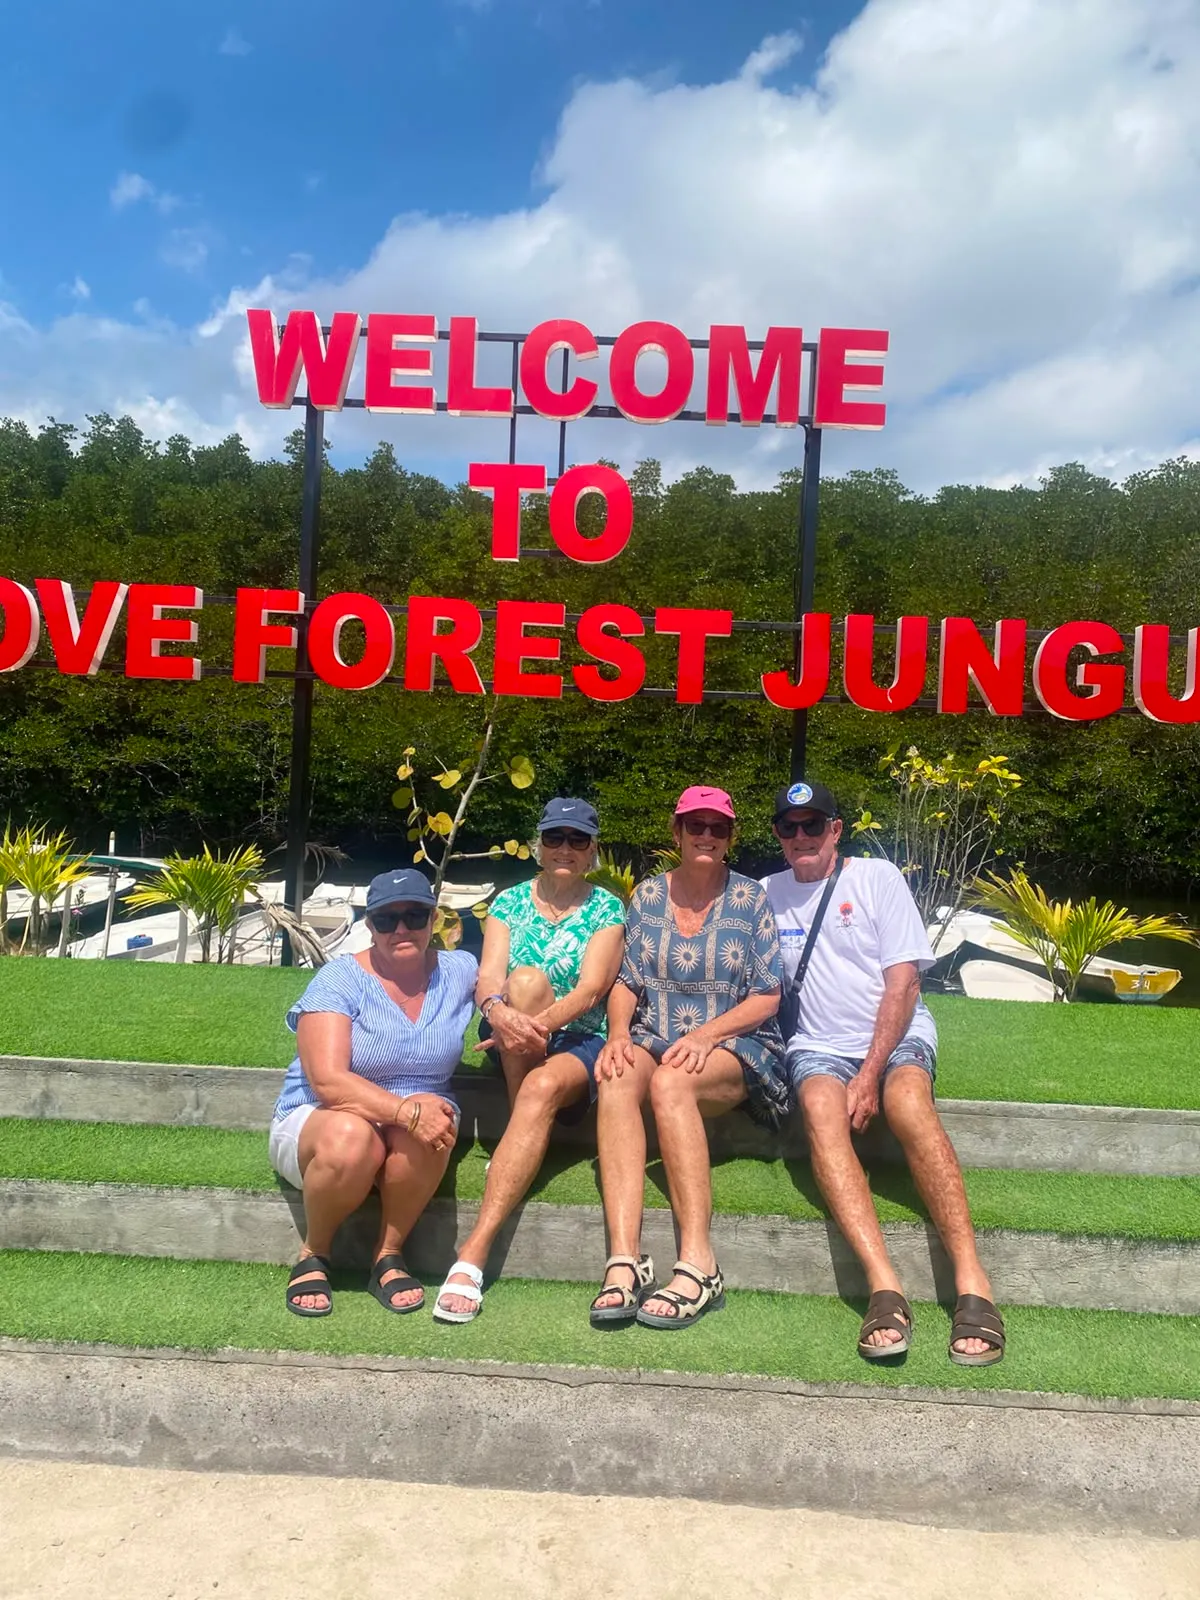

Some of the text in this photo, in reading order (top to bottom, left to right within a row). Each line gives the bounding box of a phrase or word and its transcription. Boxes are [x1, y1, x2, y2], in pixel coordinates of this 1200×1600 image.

[247, 308, 889, 431] WELCOME
[469, 462, 634, 565] TO
[233, 587, 733, 705] FOREST
[761, 612, 1200, 725] JUNGU
